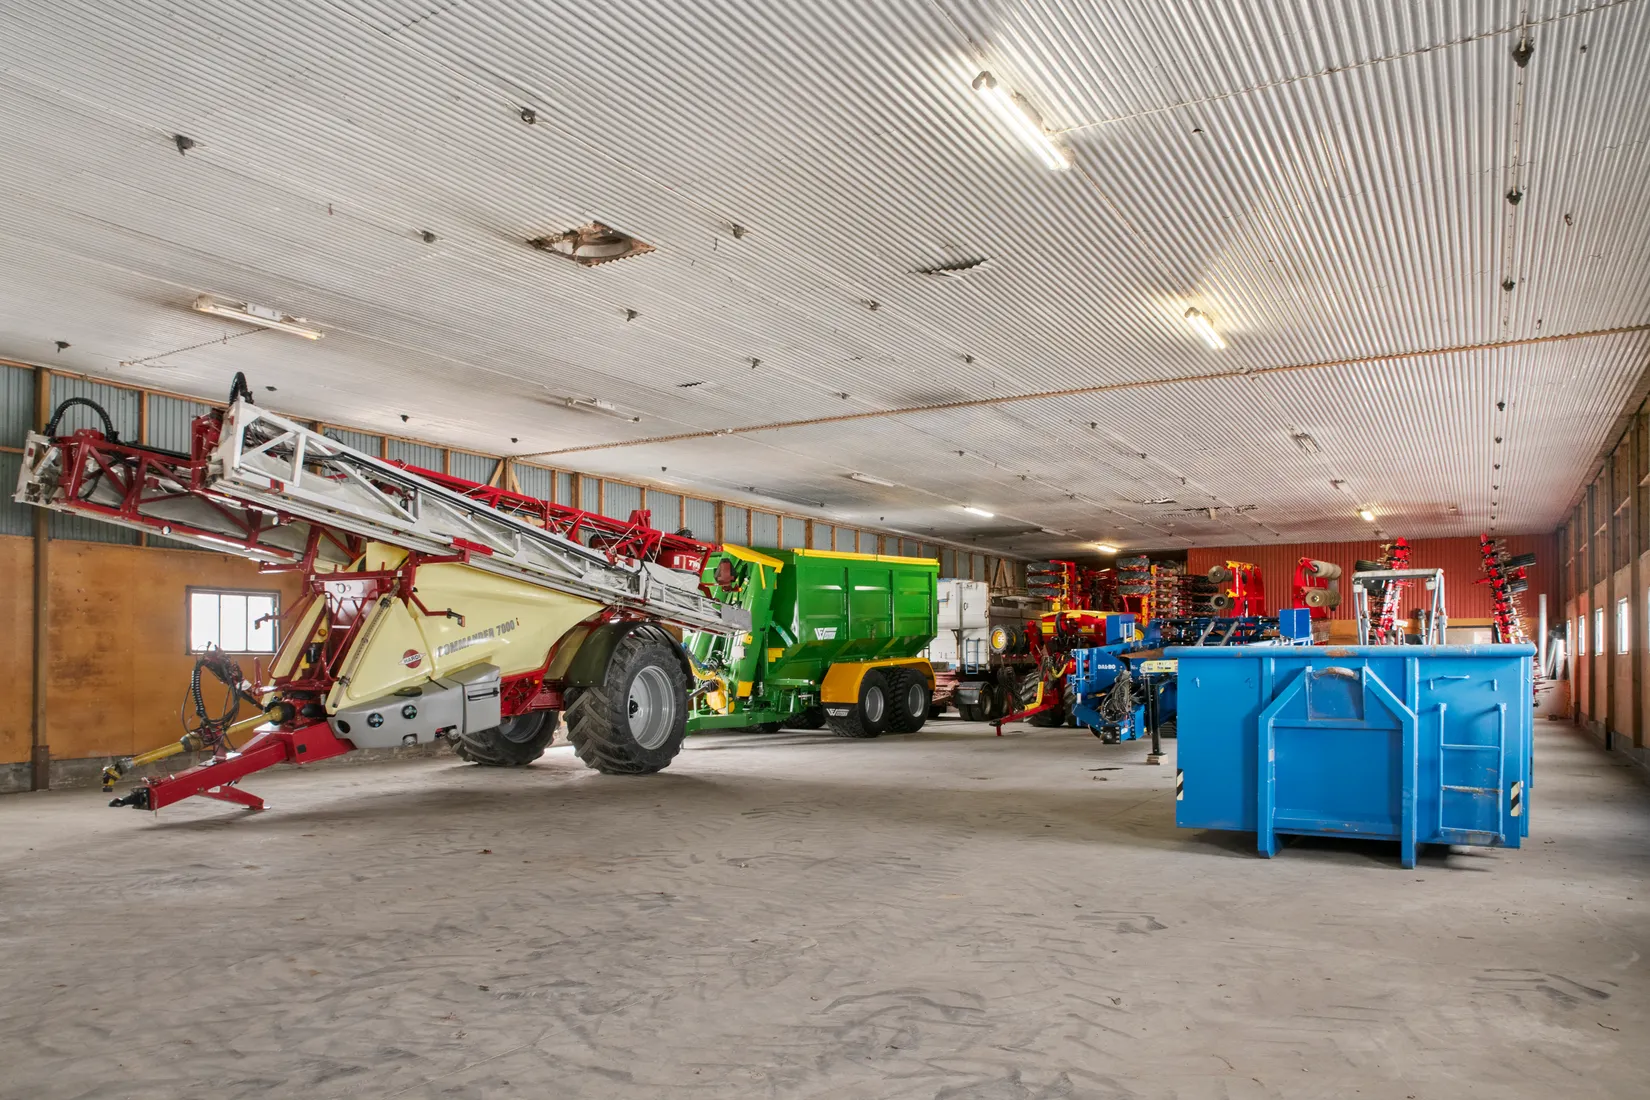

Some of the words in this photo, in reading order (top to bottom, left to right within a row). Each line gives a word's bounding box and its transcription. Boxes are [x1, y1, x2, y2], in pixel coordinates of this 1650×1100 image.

[437, 627, 495, 658] COMMANDER
[496, 620, 515, 636] 7000
[403, 653, 421, 664] HARDI
